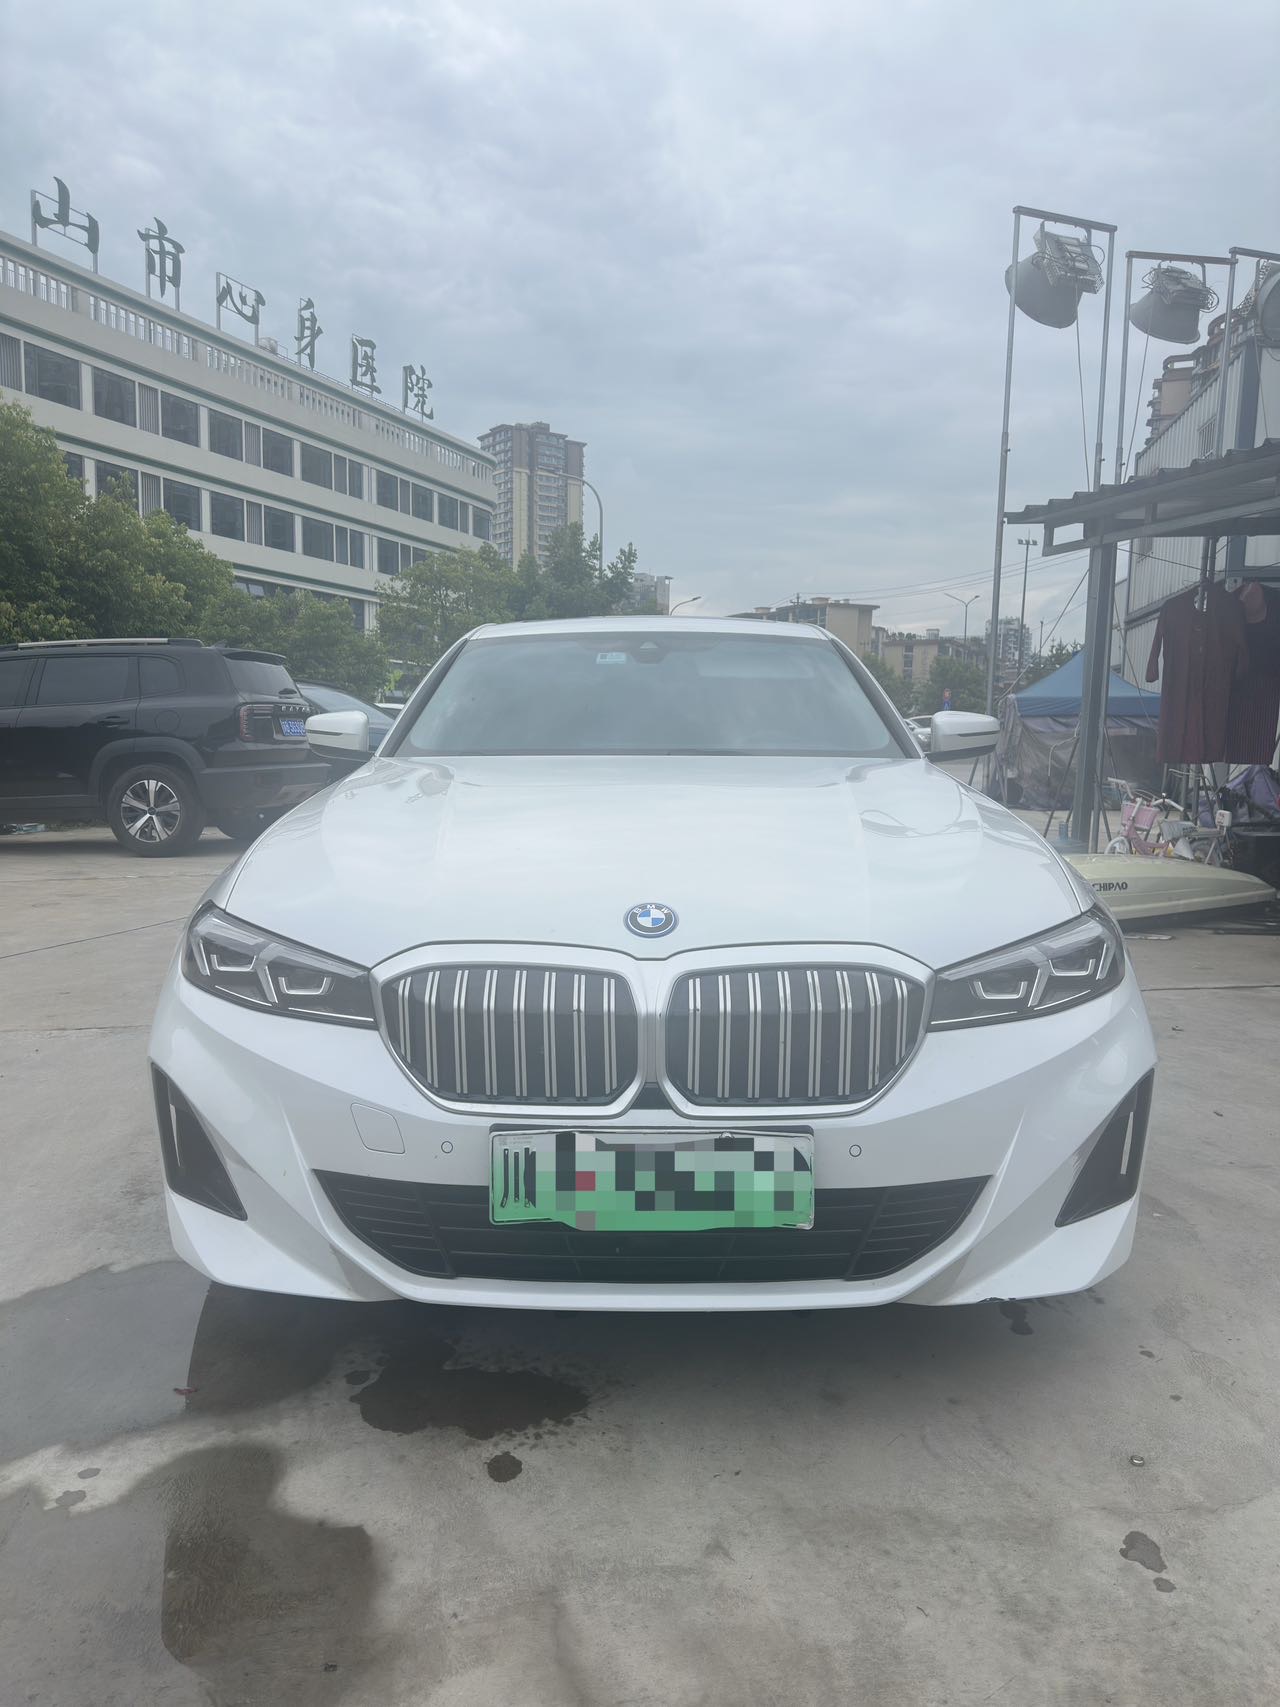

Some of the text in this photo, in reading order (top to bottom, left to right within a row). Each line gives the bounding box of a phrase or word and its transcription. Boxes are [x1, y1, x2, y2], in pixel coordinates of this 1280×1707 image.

[33, 176, 434, 420] 山市心身医院
[633, 904, 671, 914] BMW
